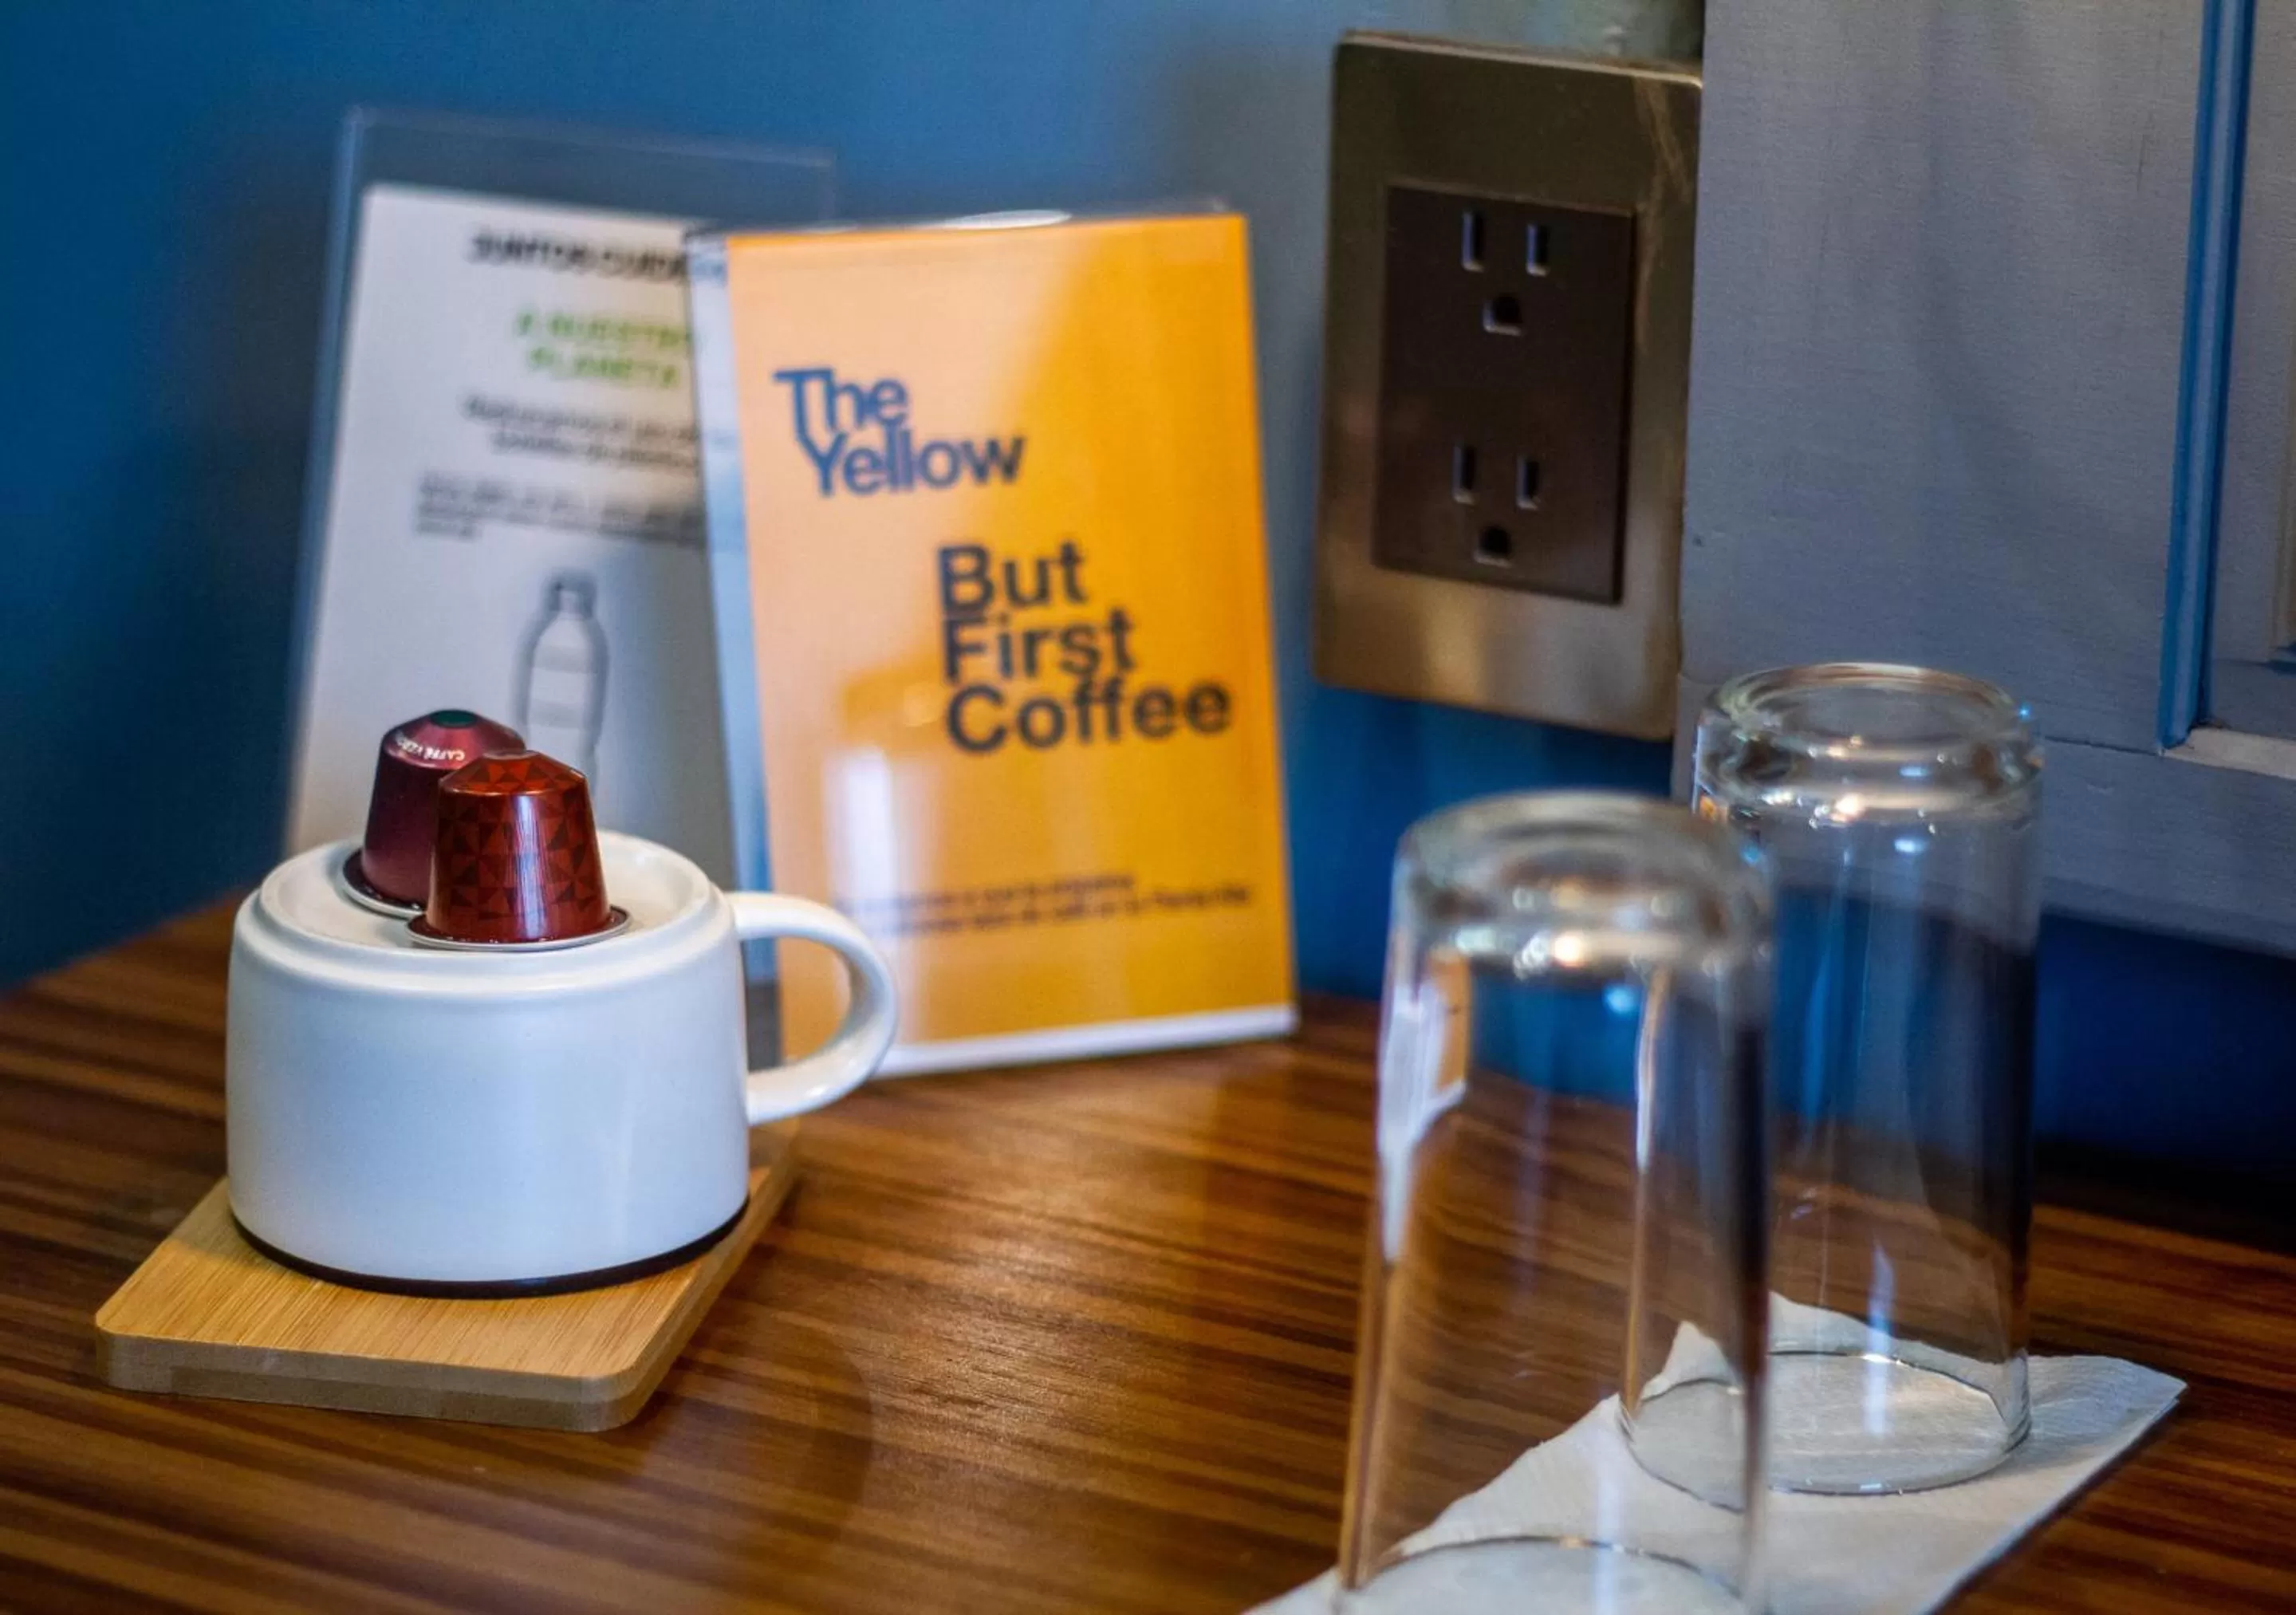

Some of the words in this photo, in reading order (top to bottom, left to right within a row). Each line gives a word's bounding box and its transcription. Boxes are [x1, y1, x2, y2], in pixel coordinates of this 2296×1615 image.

[773, 368, 909, 429] The
[797, 416, 1026, 498] Yellow
[937, 539, 1088, 616] But
[942, 606, 1136, 685] First
[945, 676, 1232, 755] Coffee
